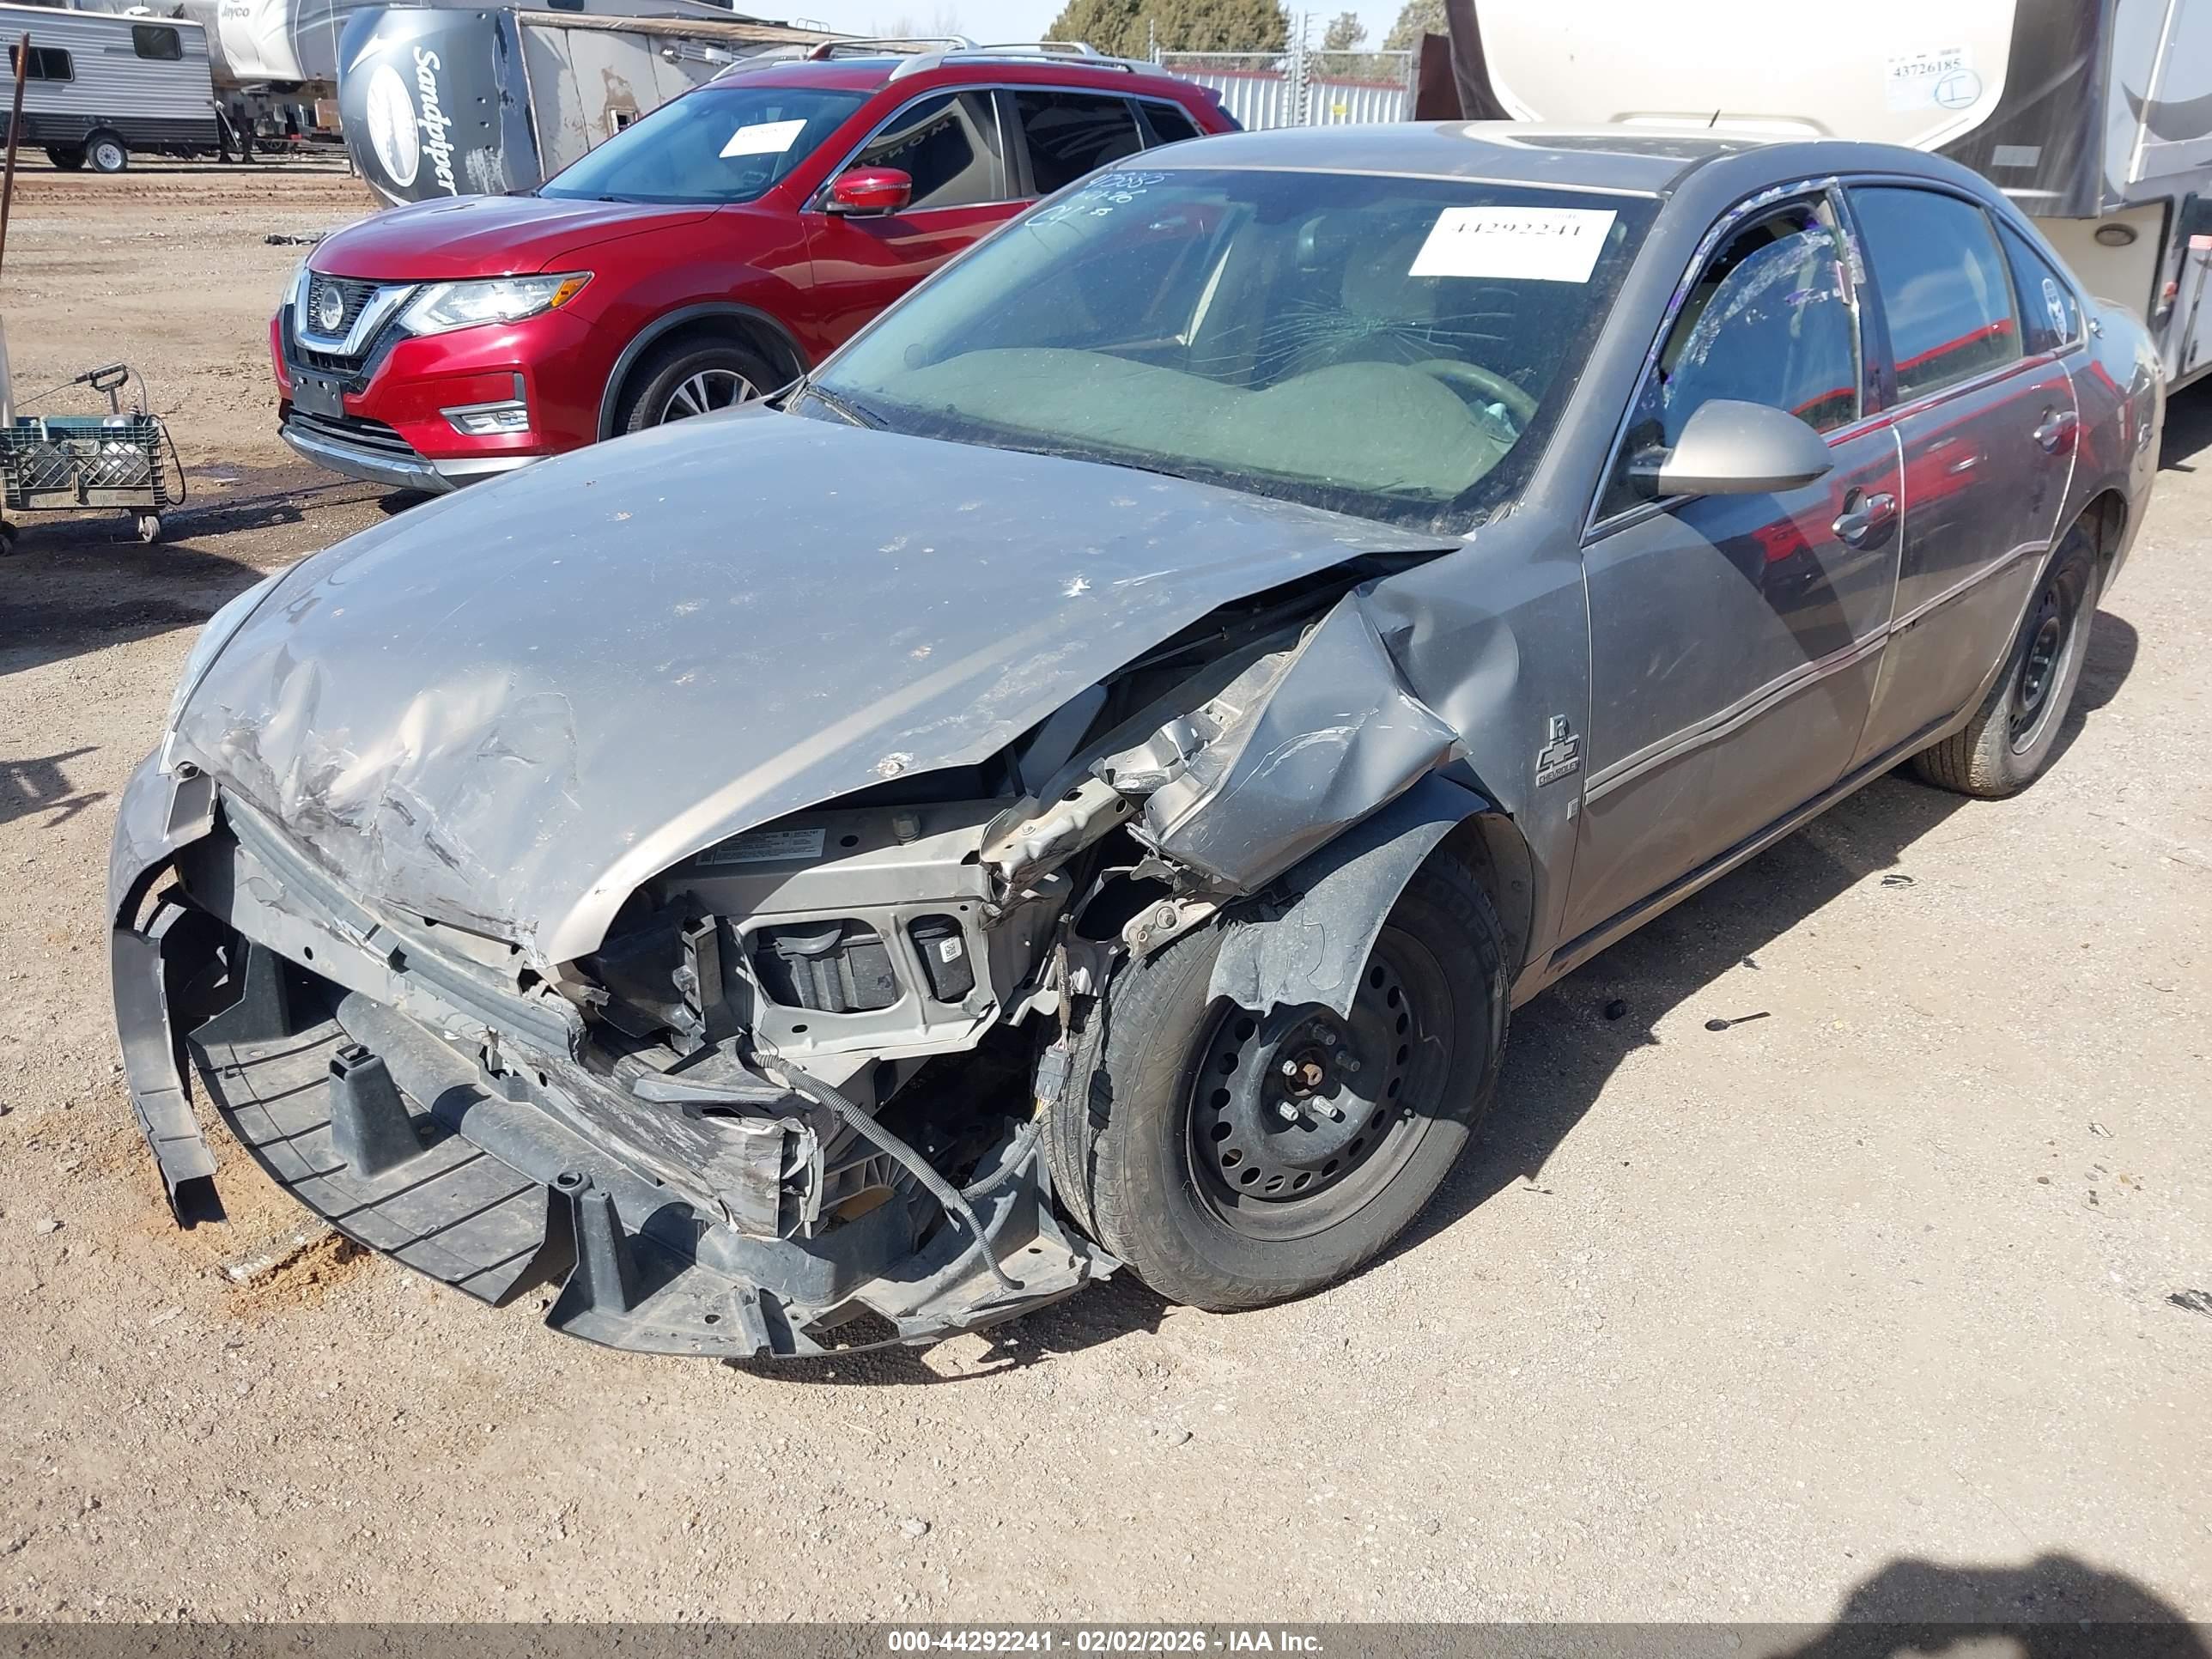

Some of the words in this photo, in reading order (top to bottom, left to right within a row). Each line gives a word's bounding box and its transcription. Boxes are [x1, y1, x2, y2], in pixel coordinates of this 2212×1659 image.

[221, 4, 250, 21] Jayco
[1893, 58, 1961, 77] 43726185
[413, 46, 458, 197] Sandpiper
[1452, 222, 1582, 236] 44292241
[1538, 761, 1579, 786] CHEVROLET
